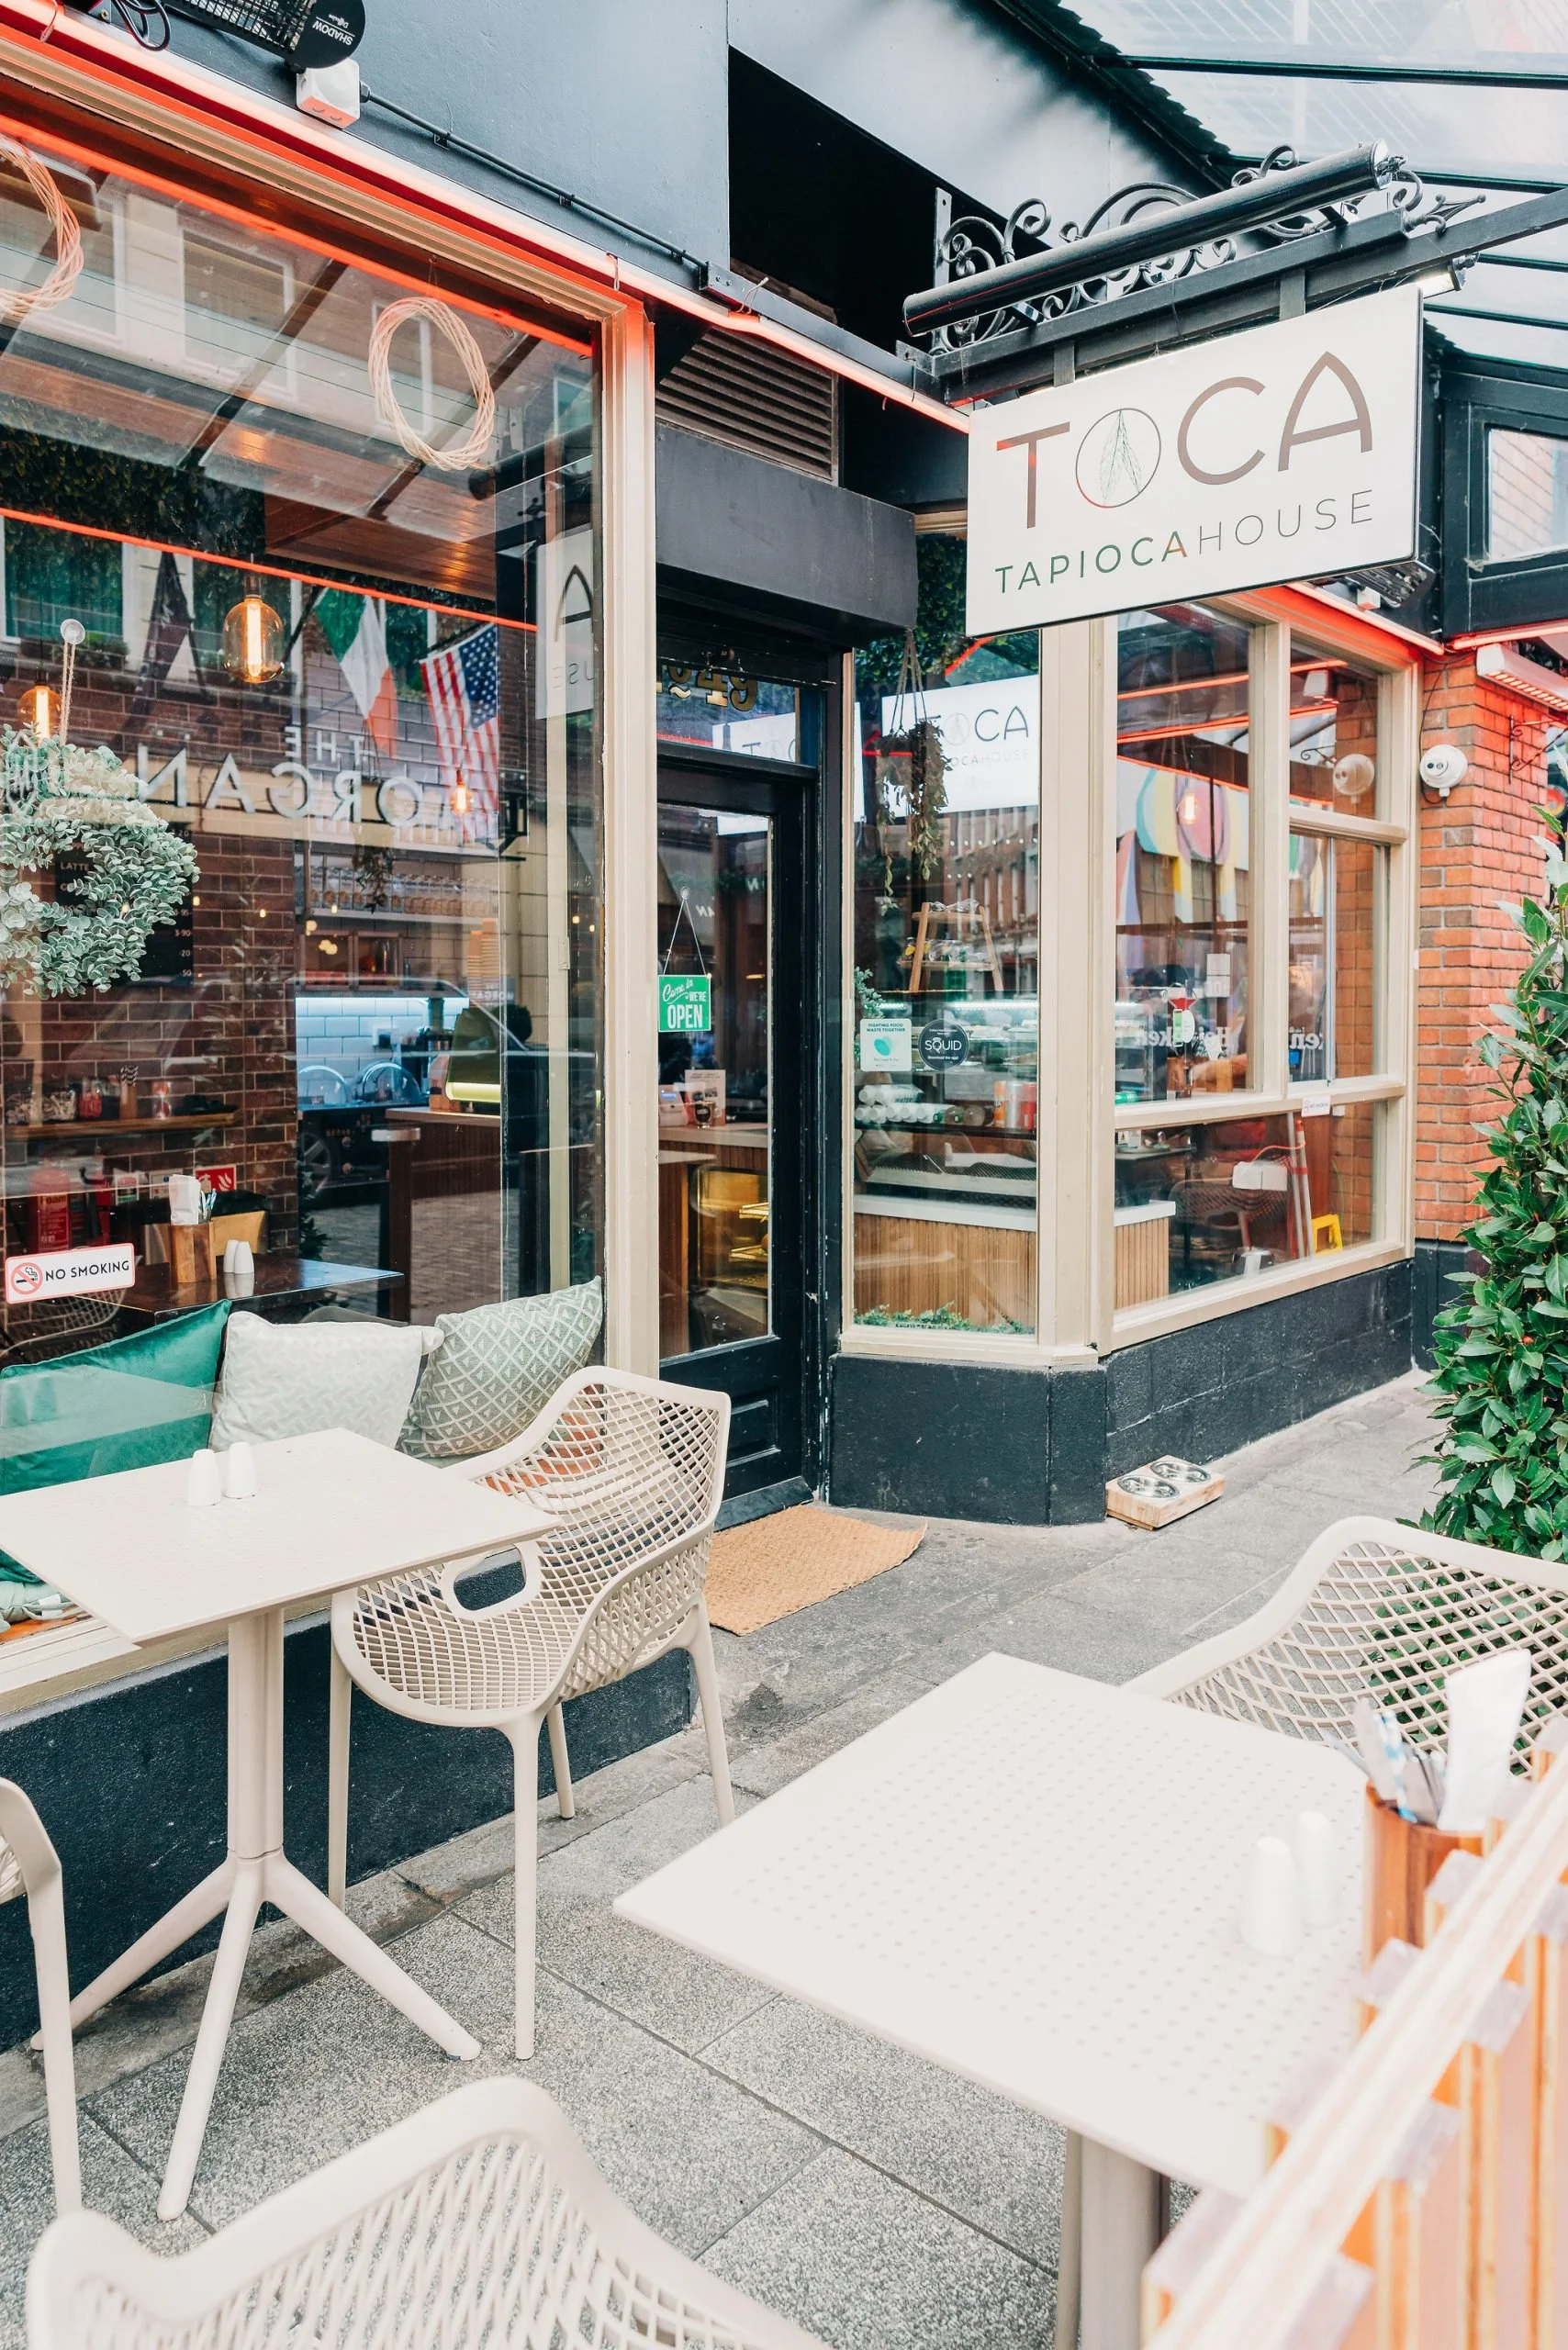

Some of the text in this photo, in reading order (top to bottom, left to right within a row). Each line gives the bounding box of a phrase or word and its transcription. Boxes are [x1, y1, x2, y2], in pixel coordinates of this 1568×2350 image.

[312, 20, 353, 46] SHADOW
[997, 351, 1373, 530] TOCA
[60, 862, 90, 871] LATTE
[667, 1004, 703, 1029] OPEN
[924, 1039, 962, 1054] SQUID
[46, 1260, 129, 1281] NO SMOKING
